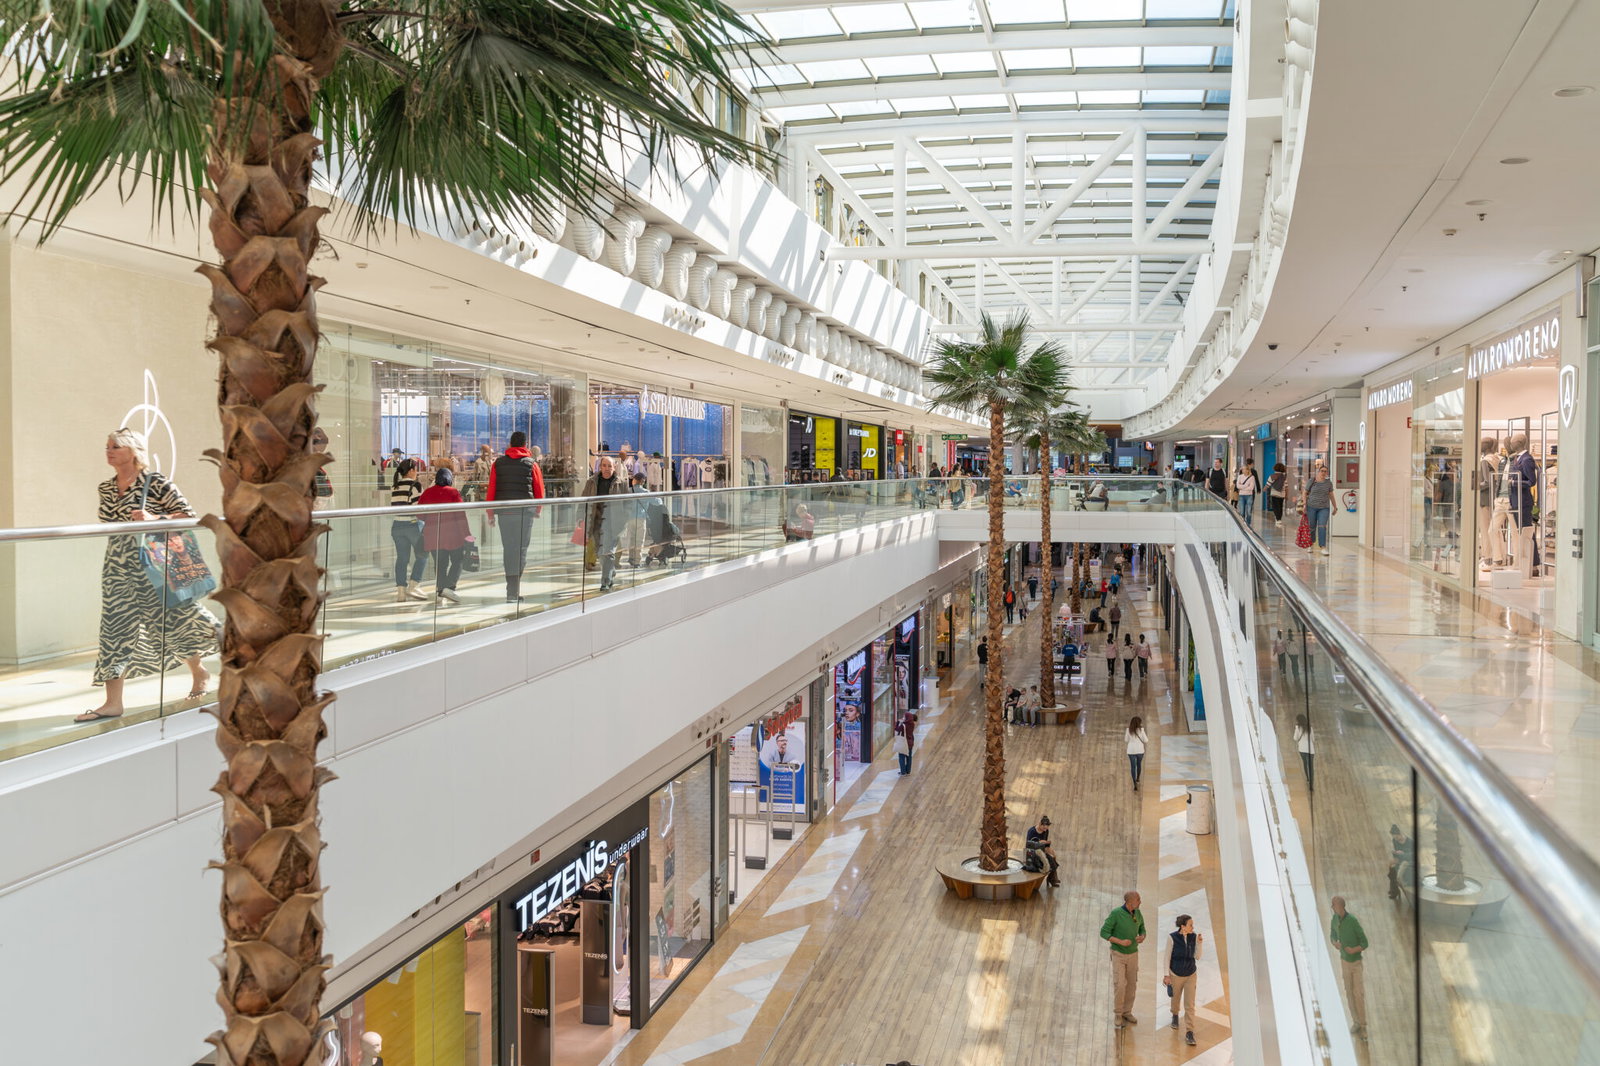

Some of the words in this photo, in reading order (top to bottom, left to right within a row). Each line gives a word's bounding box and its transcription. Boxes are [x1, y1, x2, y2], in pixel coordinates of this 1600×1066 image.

[1467, 342, 1503, 380] ALVARO
[1504, 317, 1560, 367] MORENO
[650, 391, 706, 420] STRADIVARIUS
[862, 447, 877, 458] JD
[609, 826, 649, 864] underwear
